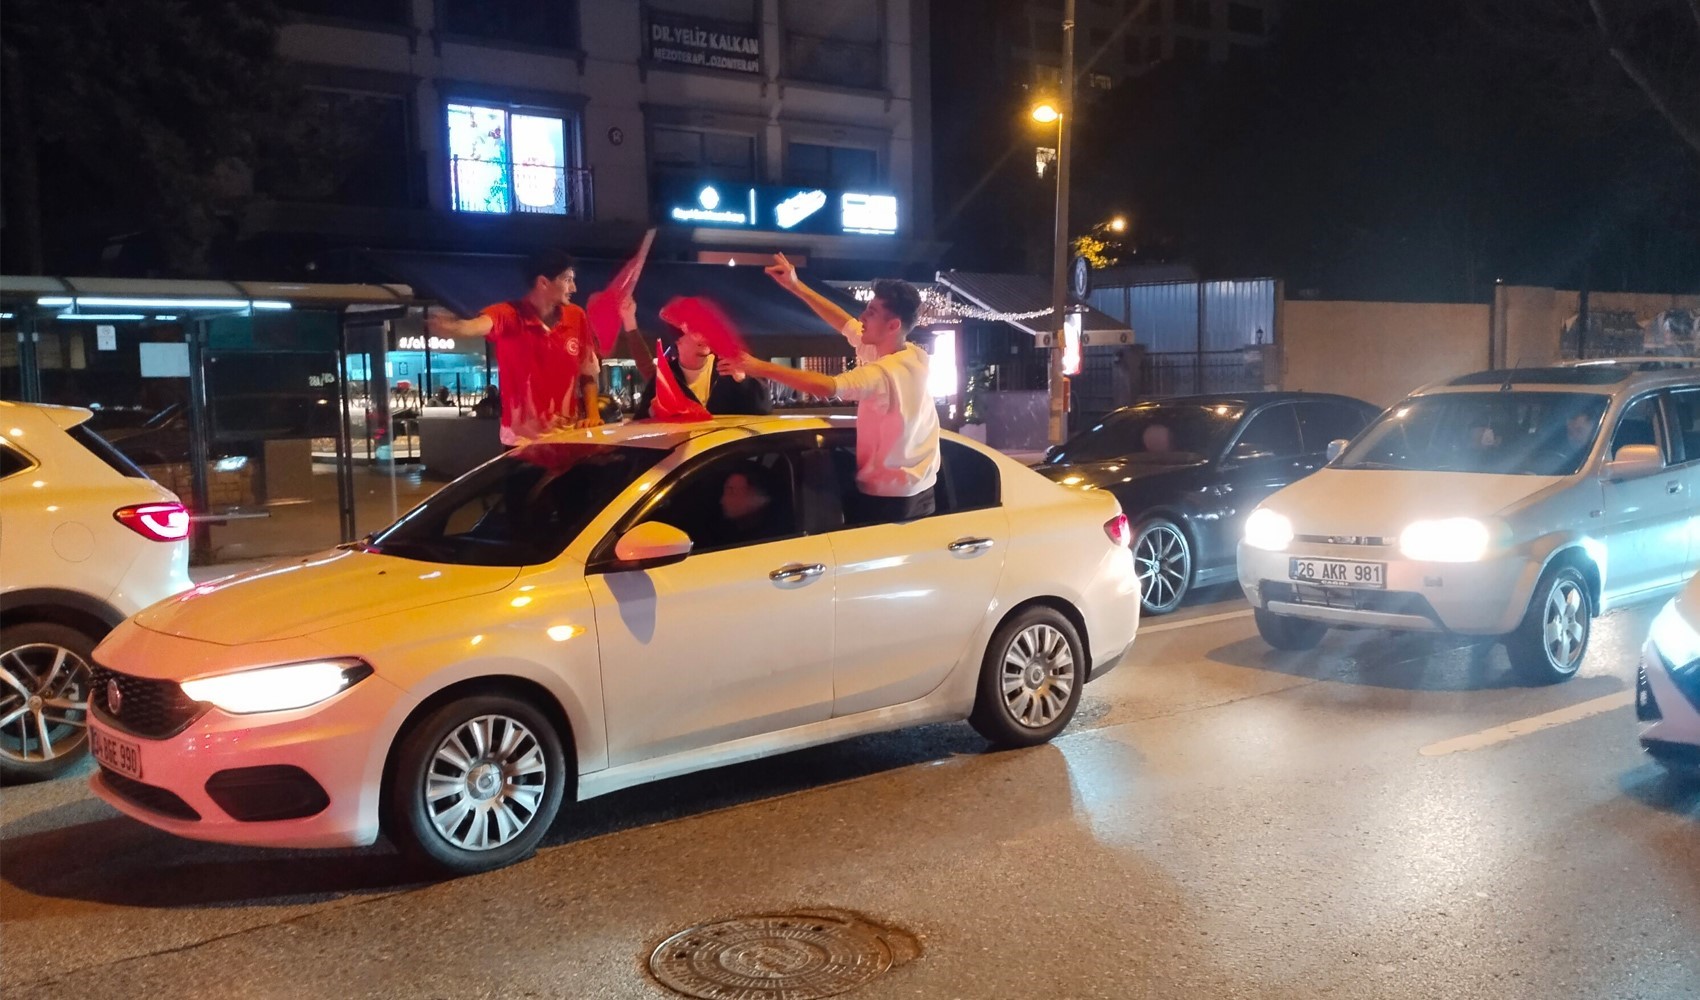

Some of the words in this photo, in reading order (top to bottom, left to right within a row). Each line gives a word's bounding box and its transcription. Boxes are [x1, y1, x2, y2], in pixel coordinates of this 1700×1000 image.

[709, 33, 759, 54] KALKAN
[1298, 562, 1315, 578] 26
[1322, 563, 1347, 581] AKR
[1354, 565, 1380, 582] 981
[120, 744, 136, 773] 990
